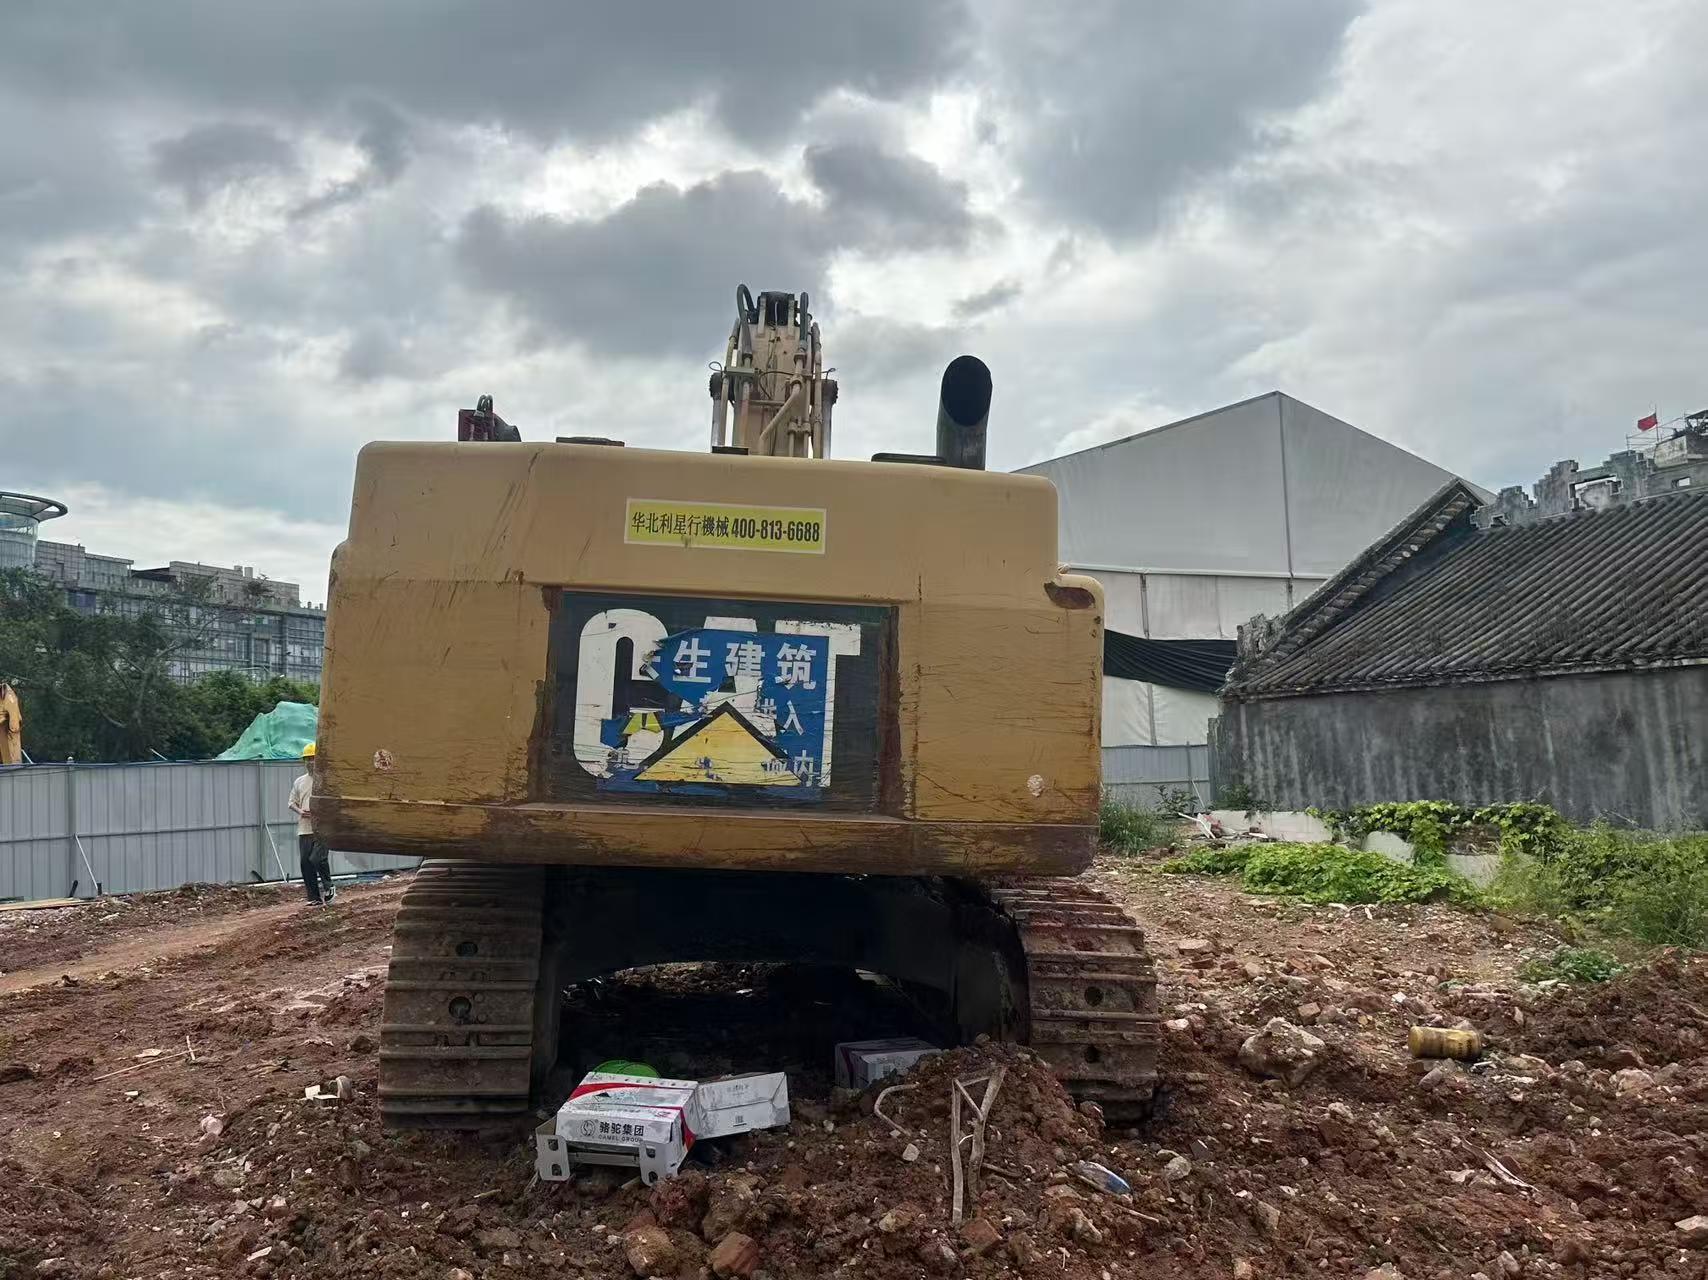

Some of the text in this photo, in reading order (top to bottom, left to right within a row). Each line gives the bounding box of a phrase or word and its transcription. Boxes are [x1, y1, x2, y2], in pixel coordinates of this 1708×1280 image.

[631, 511, 821, 543] 华北利星行機械 400-813-6688
[650, 637, 817, 690] 生建筑
[600, 1121, 645, 1137] 骆驼集团
